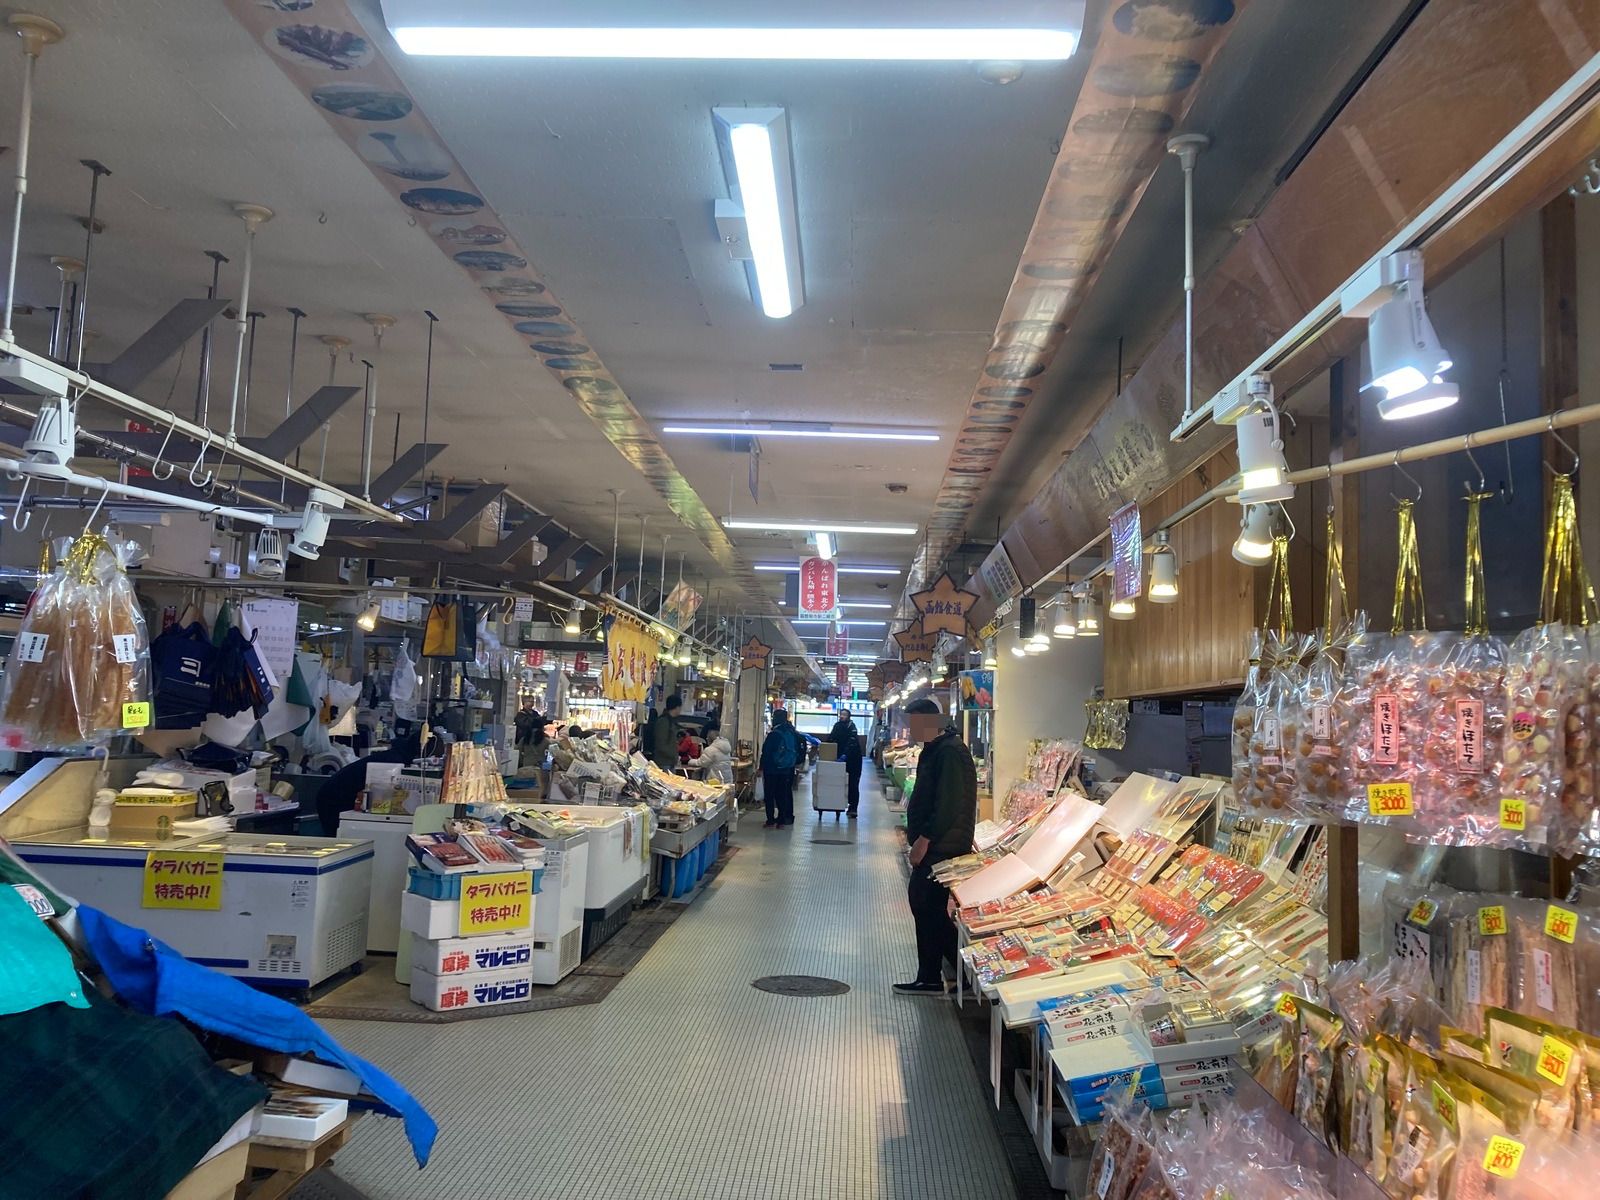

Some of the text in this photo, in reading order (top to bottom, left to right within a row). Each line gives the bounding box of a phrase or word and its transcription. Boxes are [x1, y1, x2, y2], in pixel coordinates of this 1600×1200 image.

[1380, 702, 1393, 756] 焼きほたて
[1461, 707, 1475, 765] 焼きほたて
[150, 859, 219, 875] タラバガニ
[154, 883, 211, 900] 特売中!!
[466, 881, 528, 899] タラバガニ
[470, 903, 521, 924] 特売中!!
[442, 954, 470, 973] 厚岸
[475, 948, 531, 969] マルヒロ
[440, 990, 468, 1009] 厚岸
[473, 982, 530, 1003] マルヒロ
[1082, 1011, 1116, 1027] 松前漬
[1085, 1024, 1119, 1040] 松前漬
